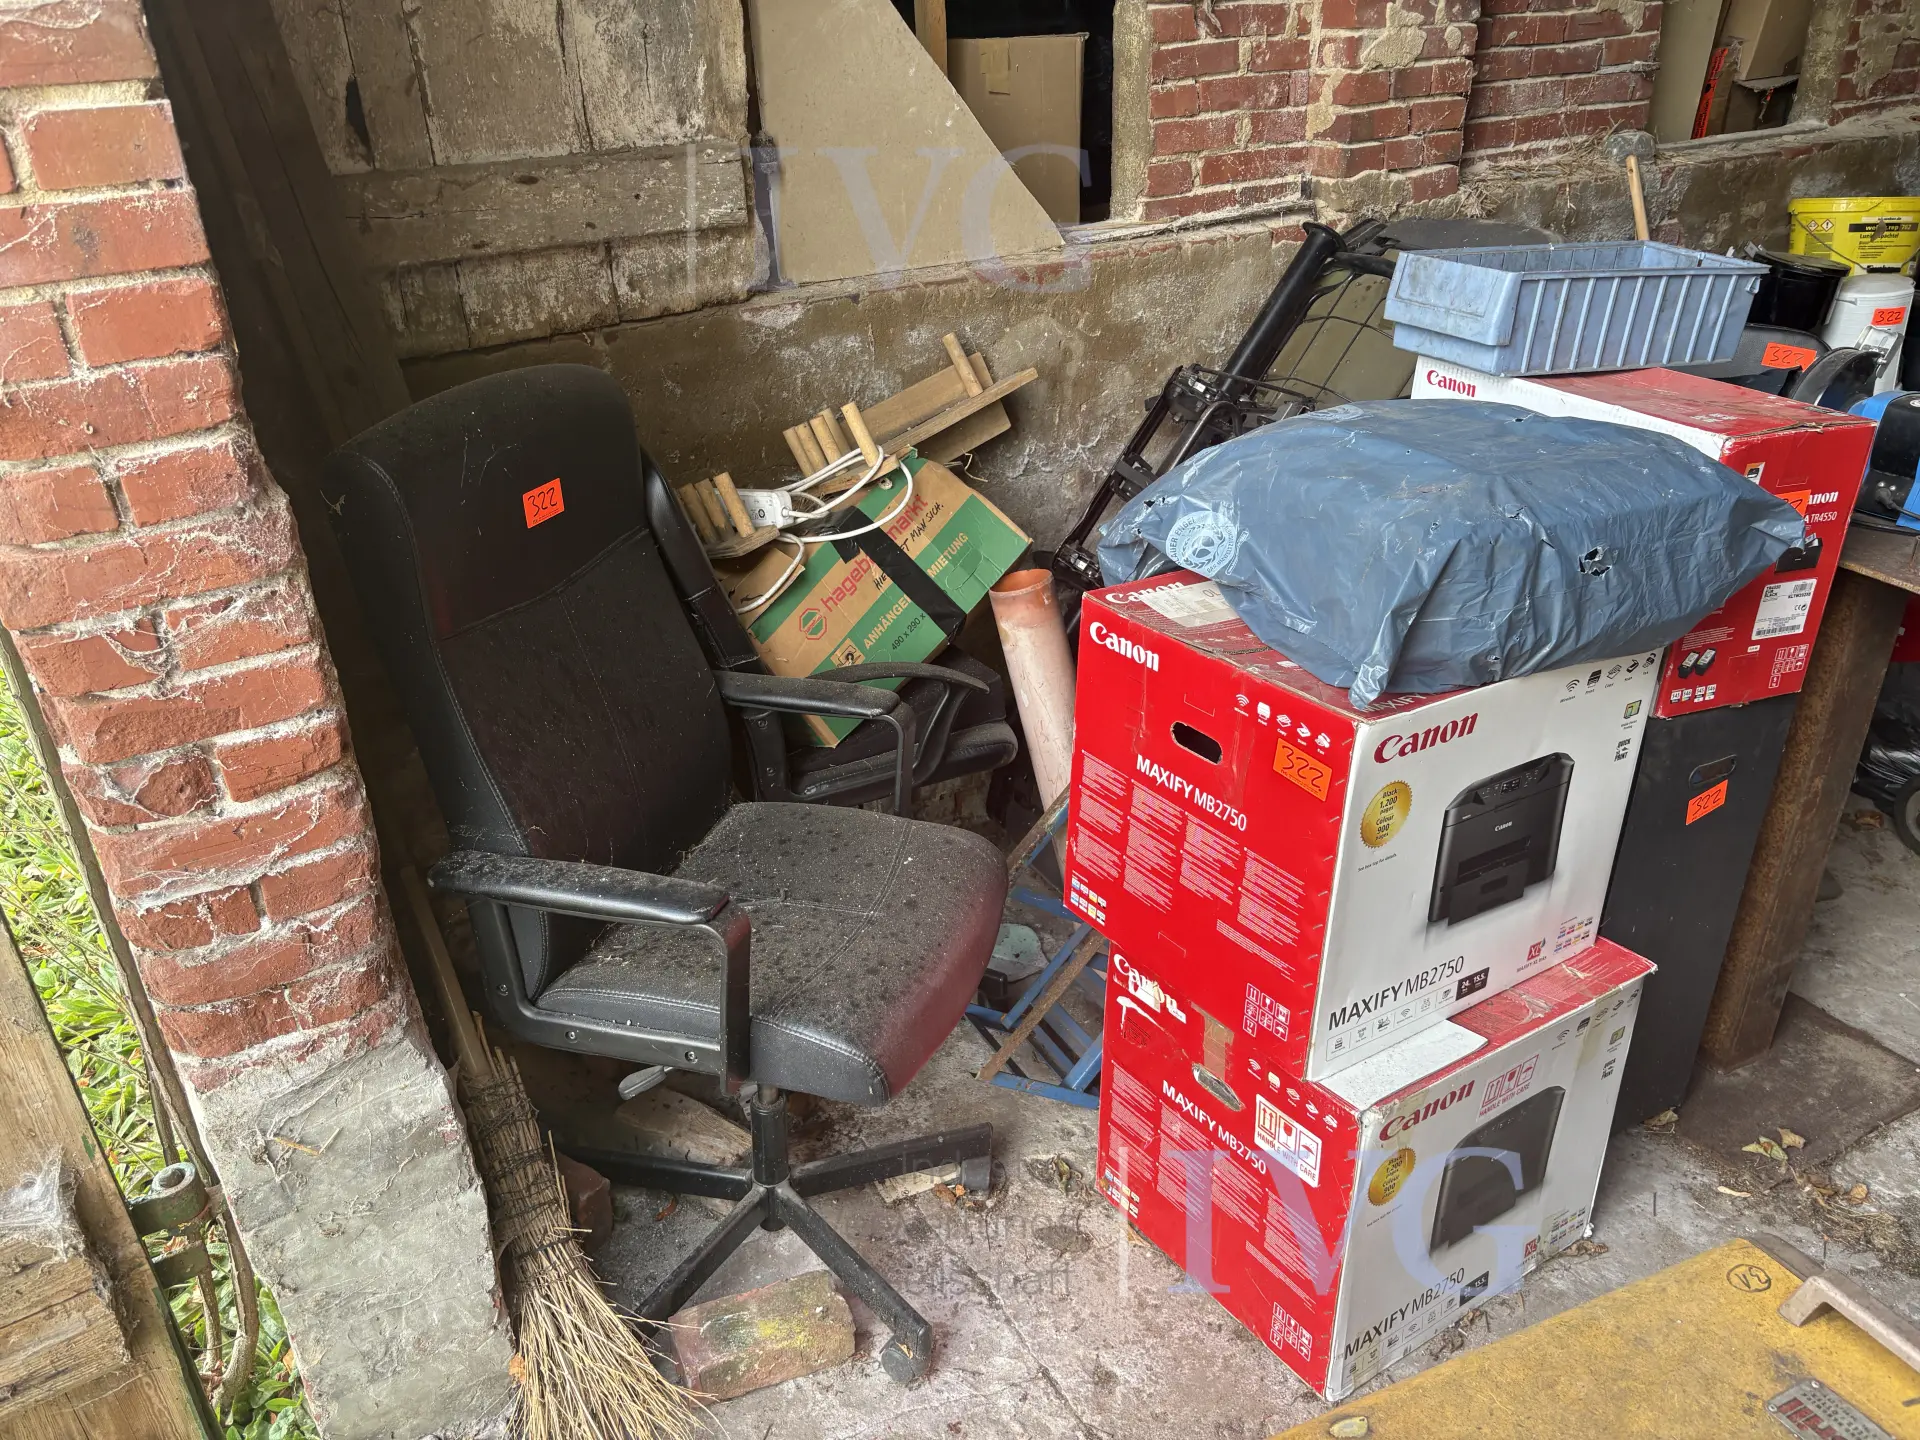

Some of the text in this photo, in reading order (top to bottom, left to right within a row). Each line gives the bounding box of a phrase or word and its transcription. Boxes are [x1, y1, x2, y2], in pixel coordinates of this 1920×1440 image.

[1877, 311, 1902, 323] 322
[1426, 369, 1477, 398] Canon
[527, 486, 558, 518] 322
[1089, 621, 1160, 672] Canon
[1373, 712, 1479, 764] Canon
[1137, 753, 1248, 832] MAXIFY MB2750
[1691, 788, 1722, 817] 322
[1328, 981, 1404, 1031] MAXIFY
[1405, 955, 1464, 997] MB2750
[1162, 1079, 1216, 1132] MAXIFY
[1217, 1122, 1267, 1175] MB2750
[1378, 1080, 1476, 1143] Canon
[1257, 1130, 1317, 1182] HANDLE WITH CARE
[1344, 1302, 1410, 1361] MAXIFY
[1411, 1267, 1465, 1314] MB2750
